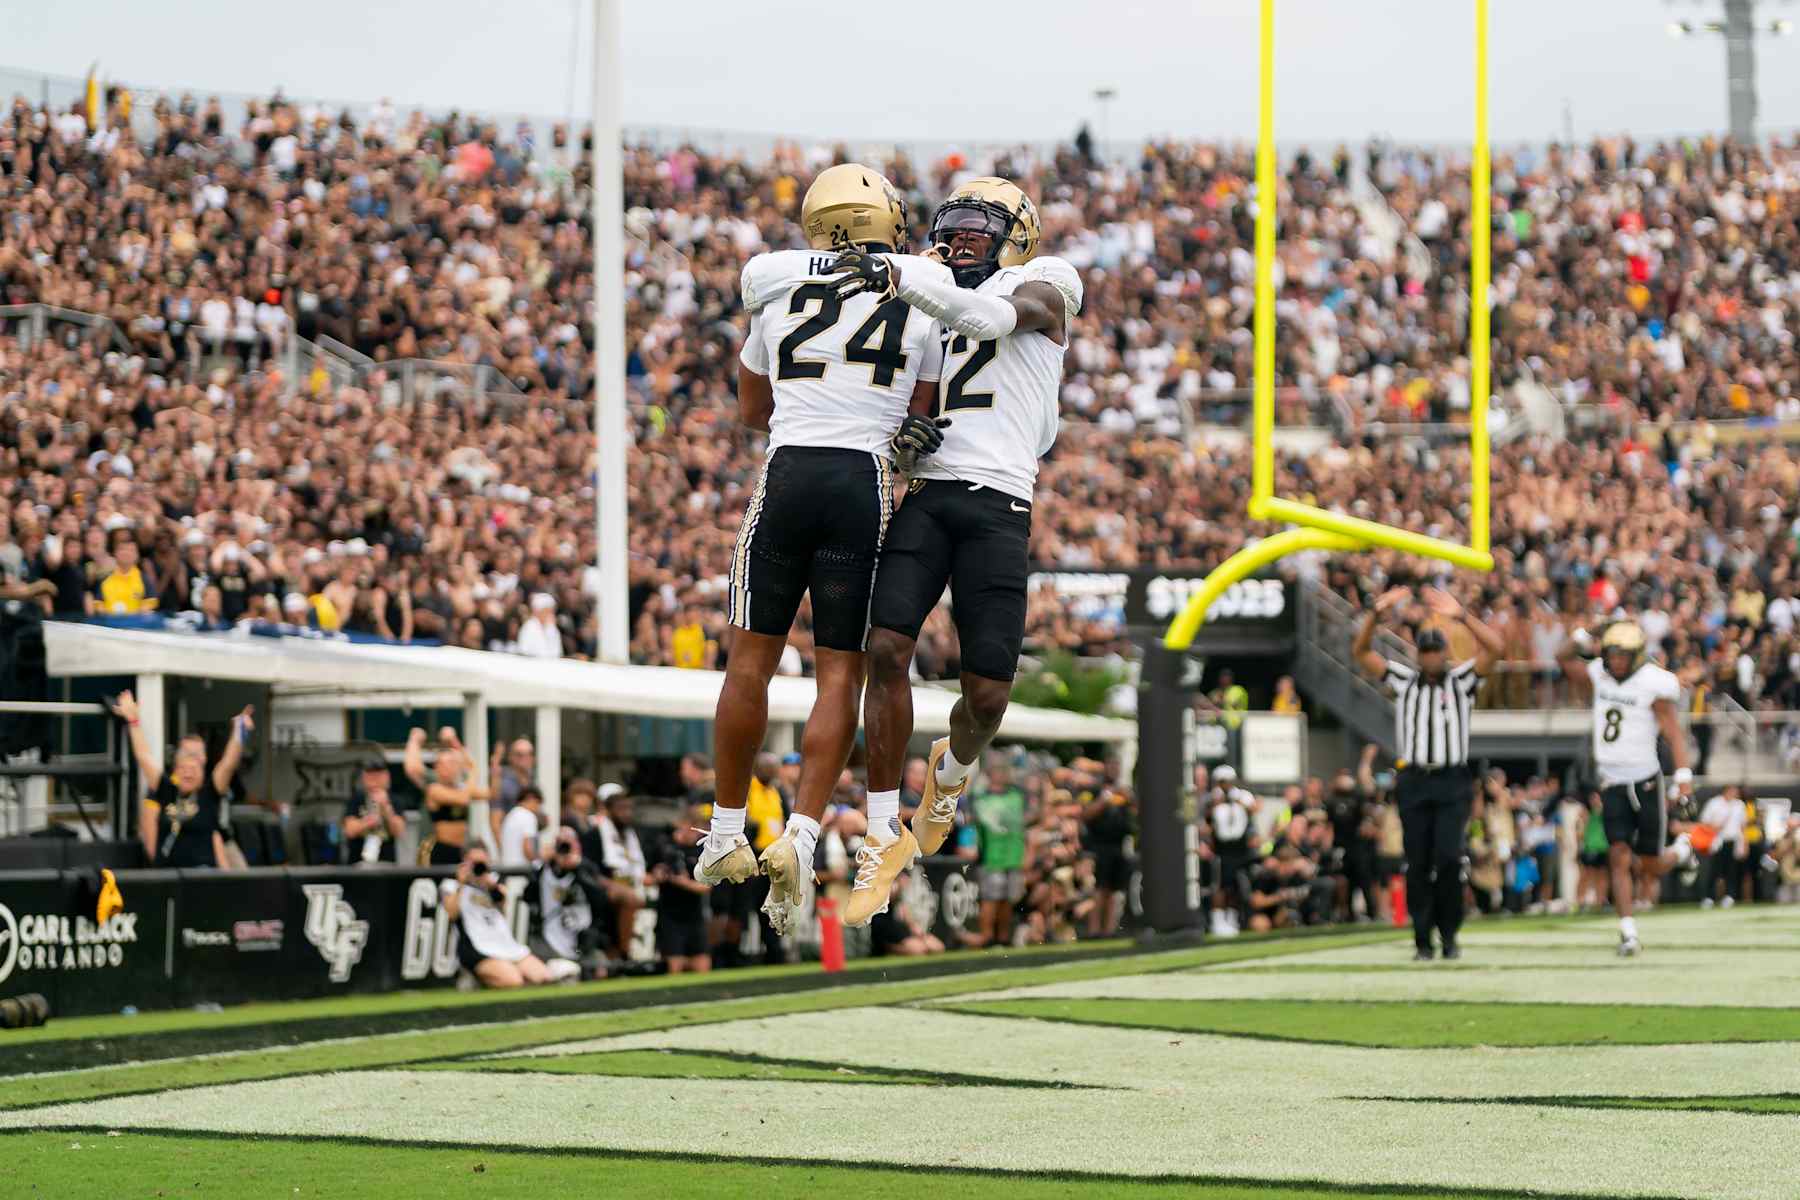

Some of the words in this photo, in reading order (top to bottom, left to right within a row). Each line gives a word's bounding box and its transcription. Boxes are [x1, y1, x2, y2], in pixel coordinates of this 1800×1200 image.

[830, 229, 849, 246] 24
[776, 282, 911, 389] 24
[1603, 708, 1622, 743] 8
[19, 915, 73, 946] CARL
[18, 943, 123, 970] ORLANDO
